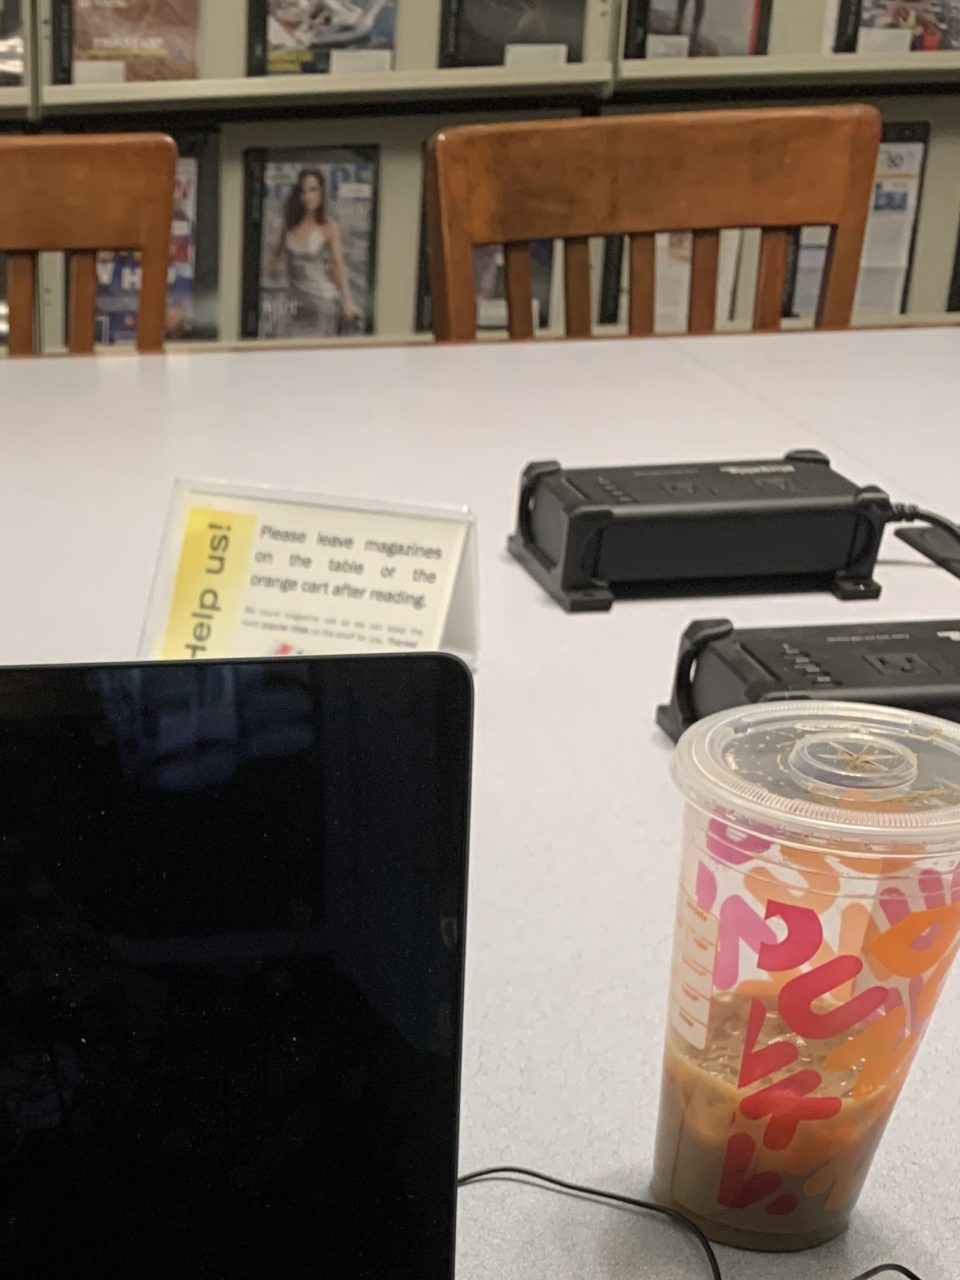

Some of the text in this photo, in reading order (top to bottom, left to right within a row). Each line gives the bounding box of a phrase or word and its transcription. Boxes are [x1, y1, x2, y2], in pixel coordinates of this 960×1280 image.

[205, 521, 232, 576] us!
[260, 523, 442, 561] Please leave magazines
[254, 550, 274, 565] on
[289, 551, 313, 569] the
[328, 556, 365, 575] table
[412, 567, 437, 585] the
[249, 573, 427, 611] orange cart after reading.
